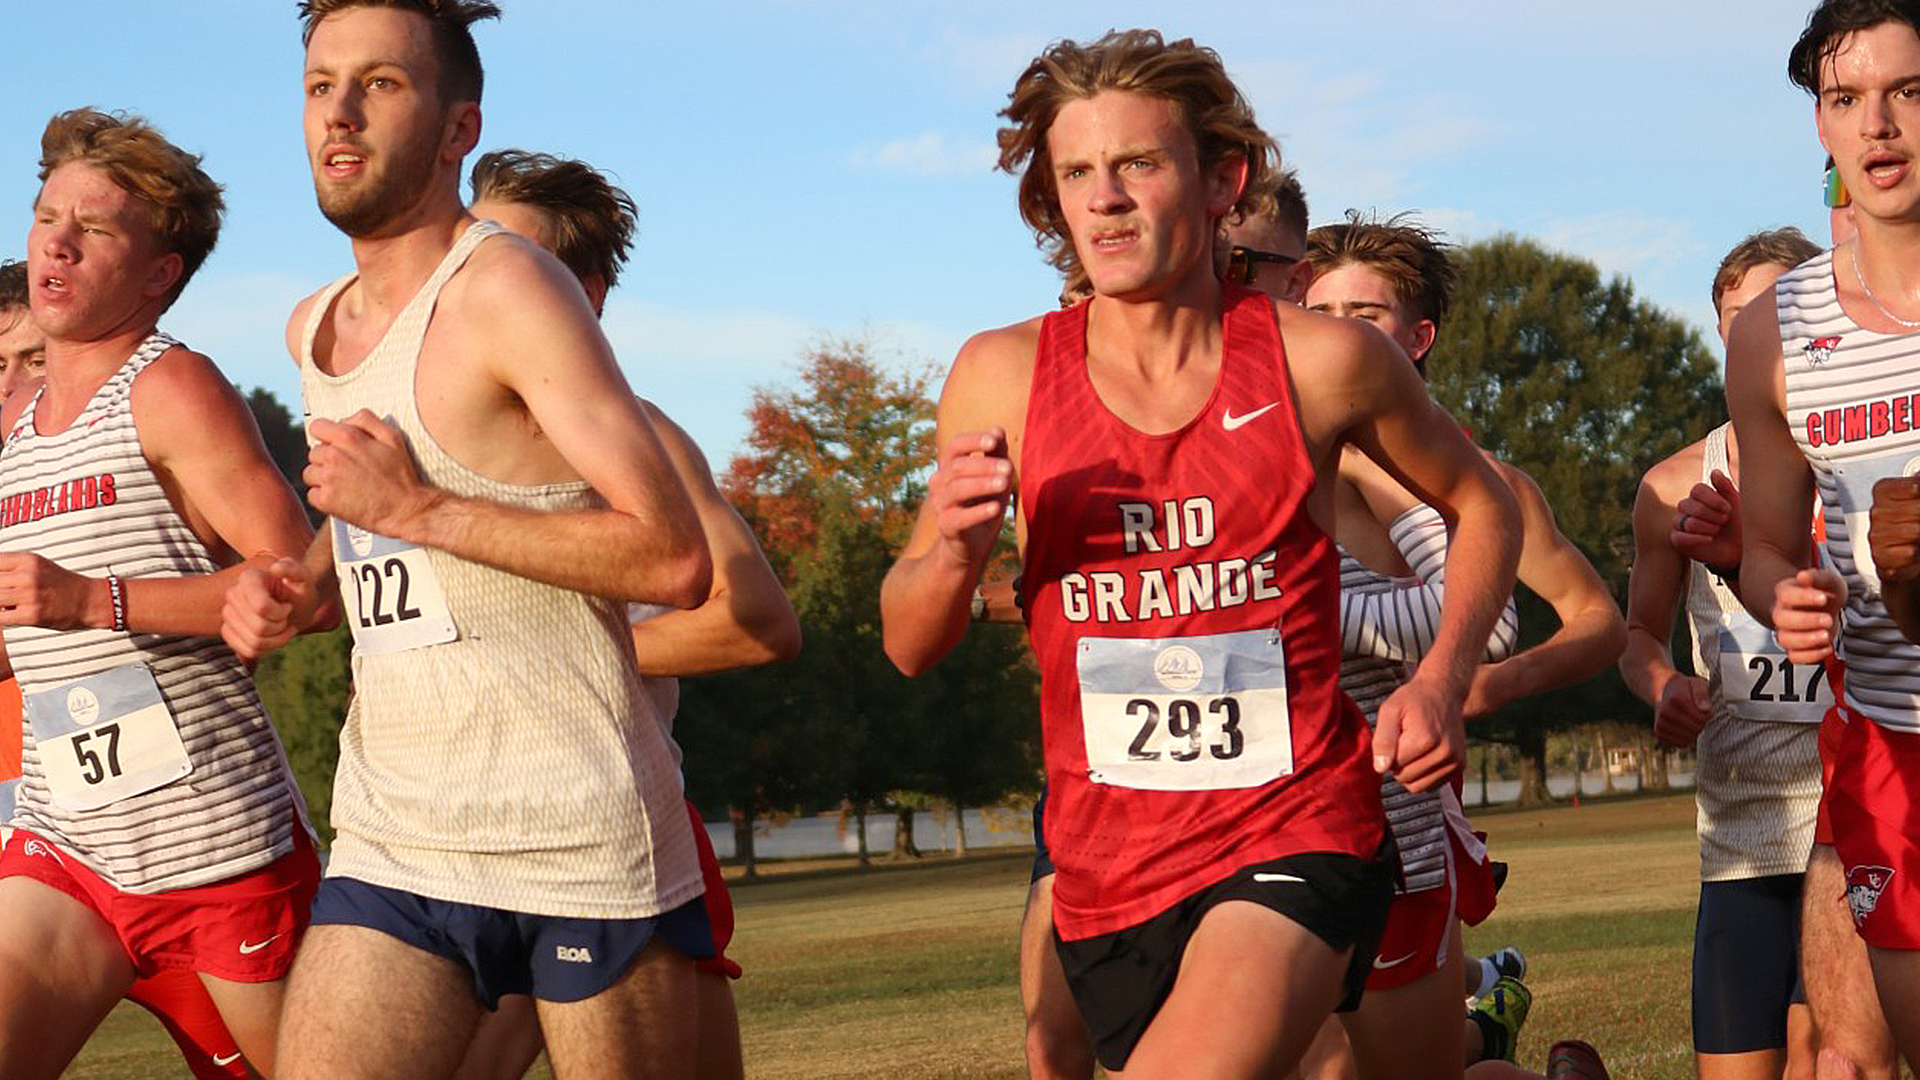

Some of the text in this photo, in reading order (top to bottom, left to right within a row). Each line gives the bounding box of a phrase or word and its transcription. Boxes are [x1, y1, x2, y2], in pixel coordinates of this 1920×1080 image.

[1119, 496, 1216, 553] RIO
[1060, 550, 1283, 623] GRANDE
[1748, 656, 1826, 702] 217
[71, 723, 122, 785] 57
[1125, 696, 1245, 762] 293
[556, 945, 593, 963] BOA
